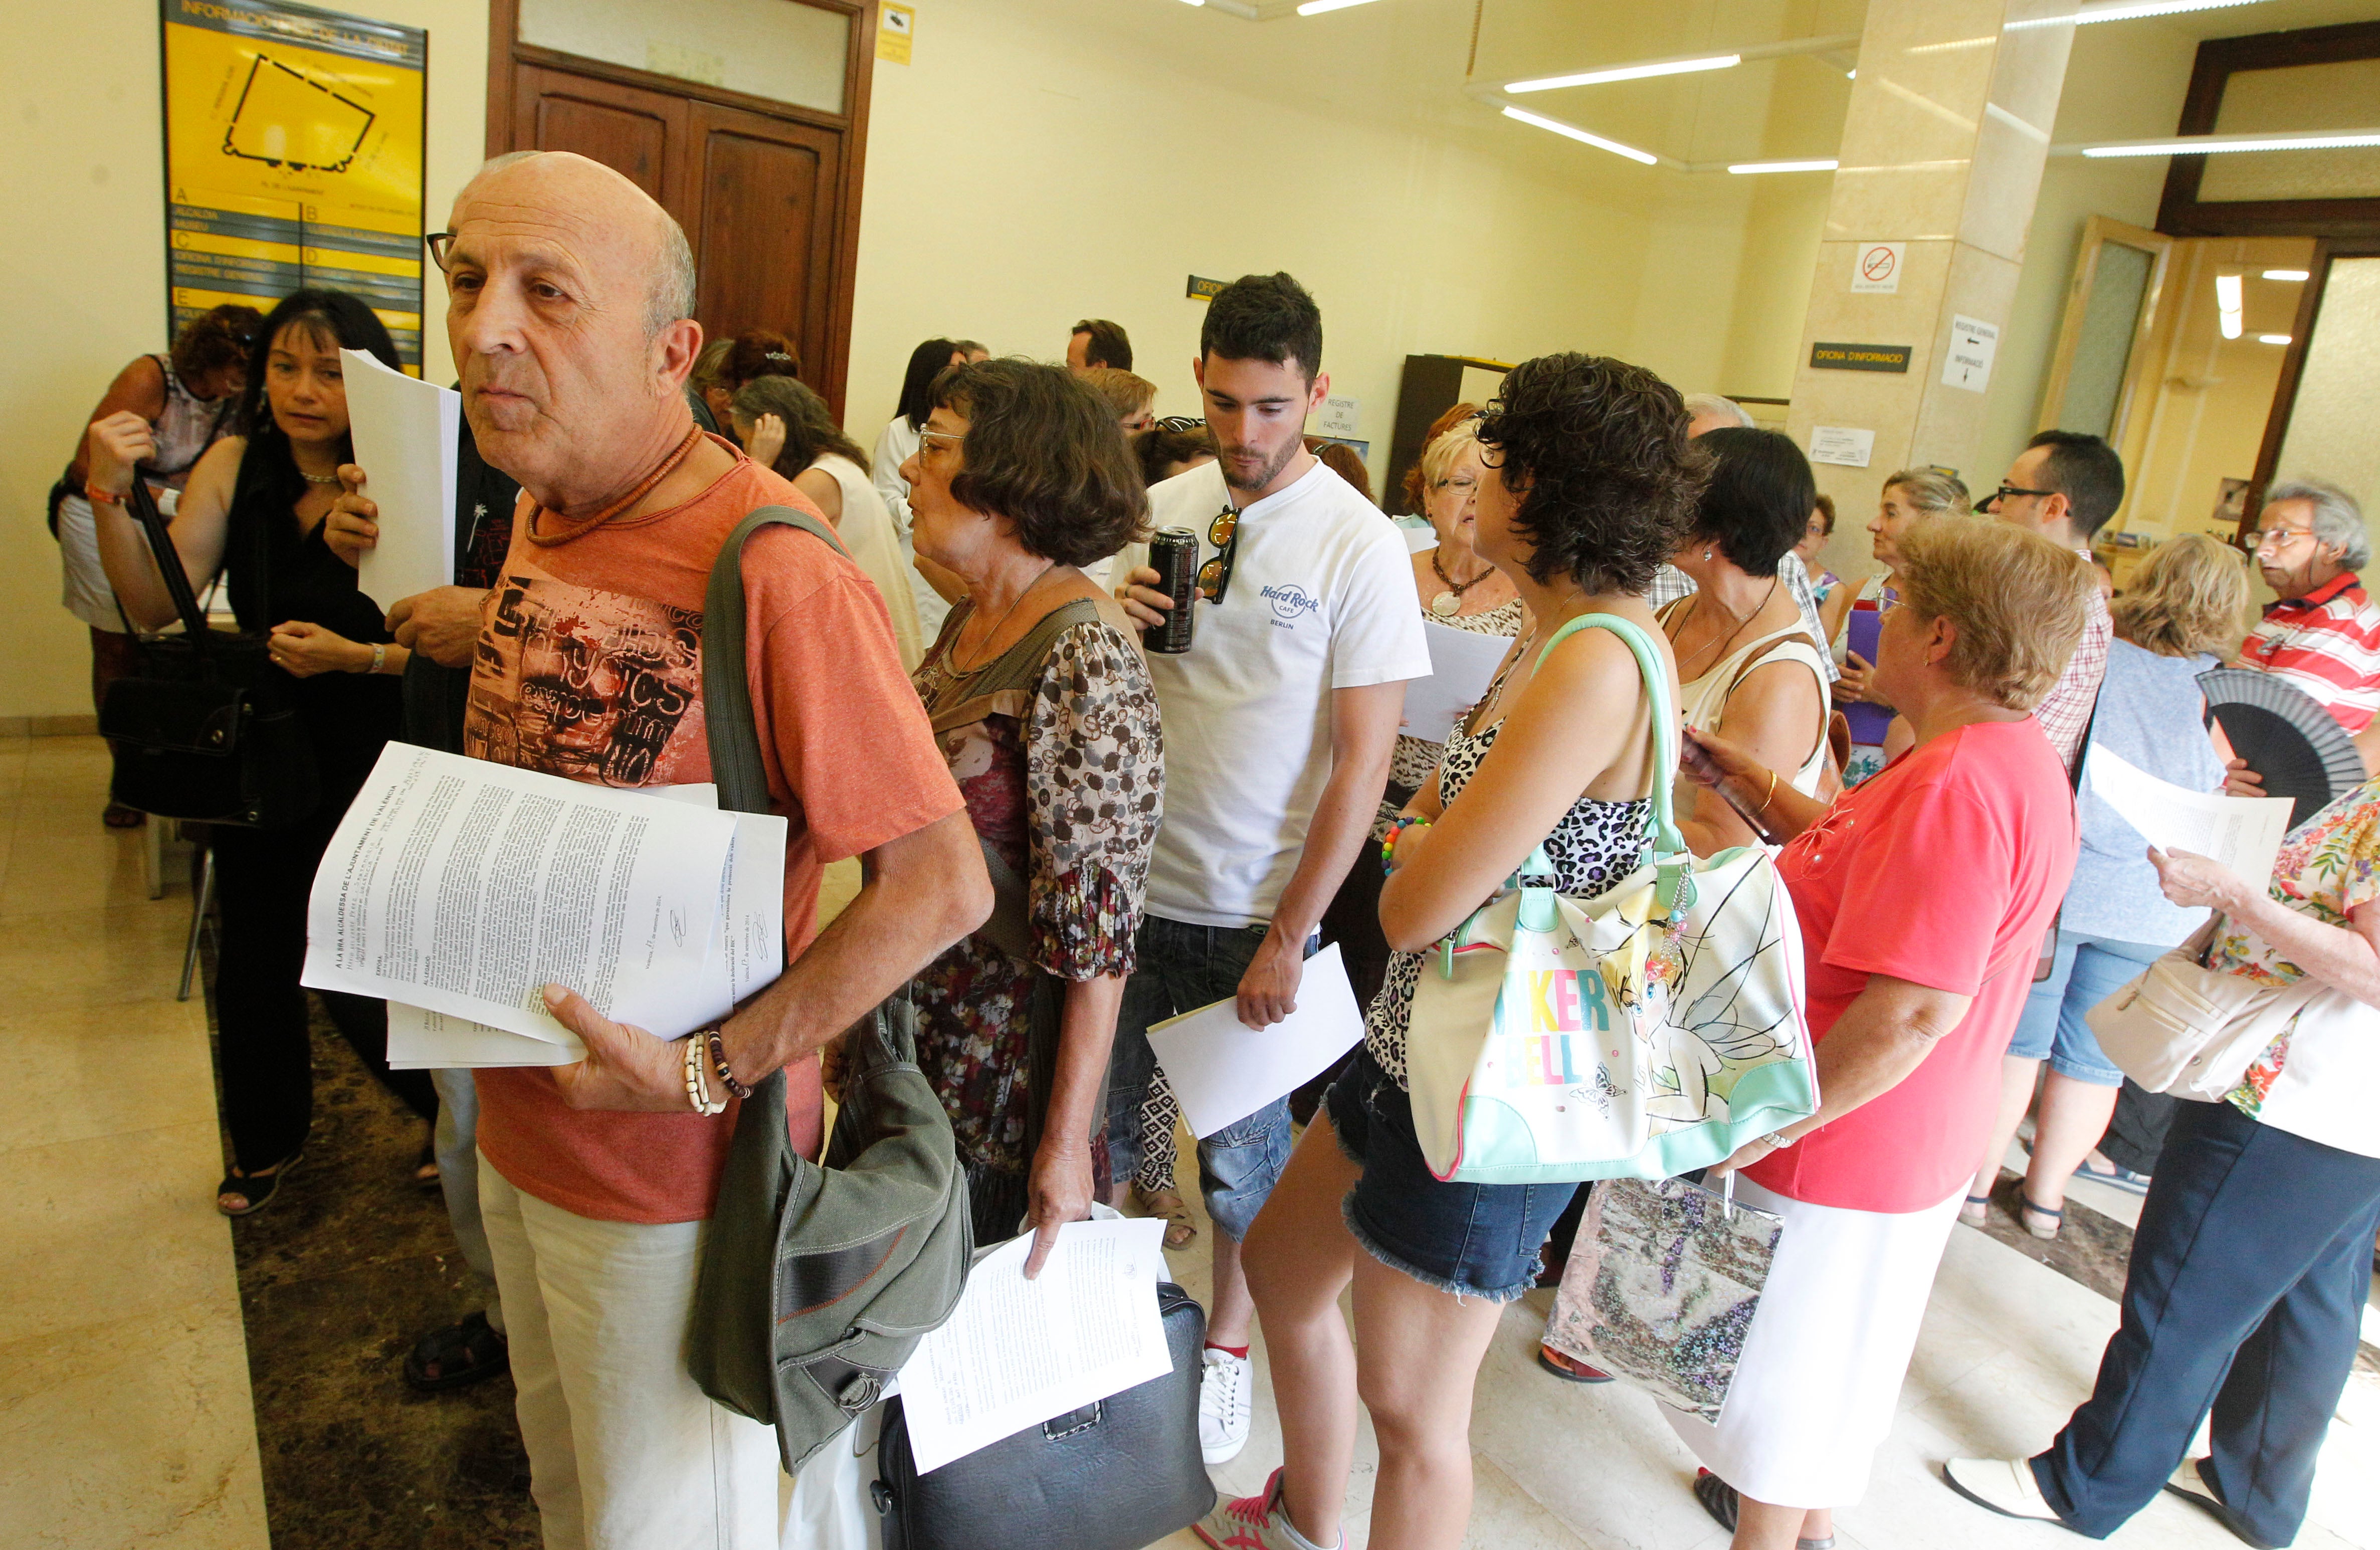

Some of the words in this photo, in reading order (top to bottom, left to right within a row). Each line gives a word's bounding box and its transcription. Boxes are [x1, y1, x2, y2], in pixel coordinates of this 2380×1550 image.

[177, 187, 186, 201] A
[306, 206, 317, 220] B
[176, 233, 189, 248] C
[306, 249, 318, 262] D
[177, 290, 187, 304] E
[1817, 350, 1846, 360] OFICINA
[1328, 399, 1354, 409] REGISTRE
[1323, 421, 1352, 431] FACTURES
[1260, 586, 1292, 602] Hard
[1290, 593, 1319, 612] Rock
[1270, 619, 1294, 630] BERLIN
[374, 786, 397, 816] VALÈNCIA
[369, 818, 377, 826] DE
[345, 828, 372, 879] L'AJUNTAMENT
[342, 881, 349, 891] DE
[337, 893, 346, 935] ALCALDESSA
[336, 953, 343, 961] LA
[1504, 1034, 1583, 1088] BELL
